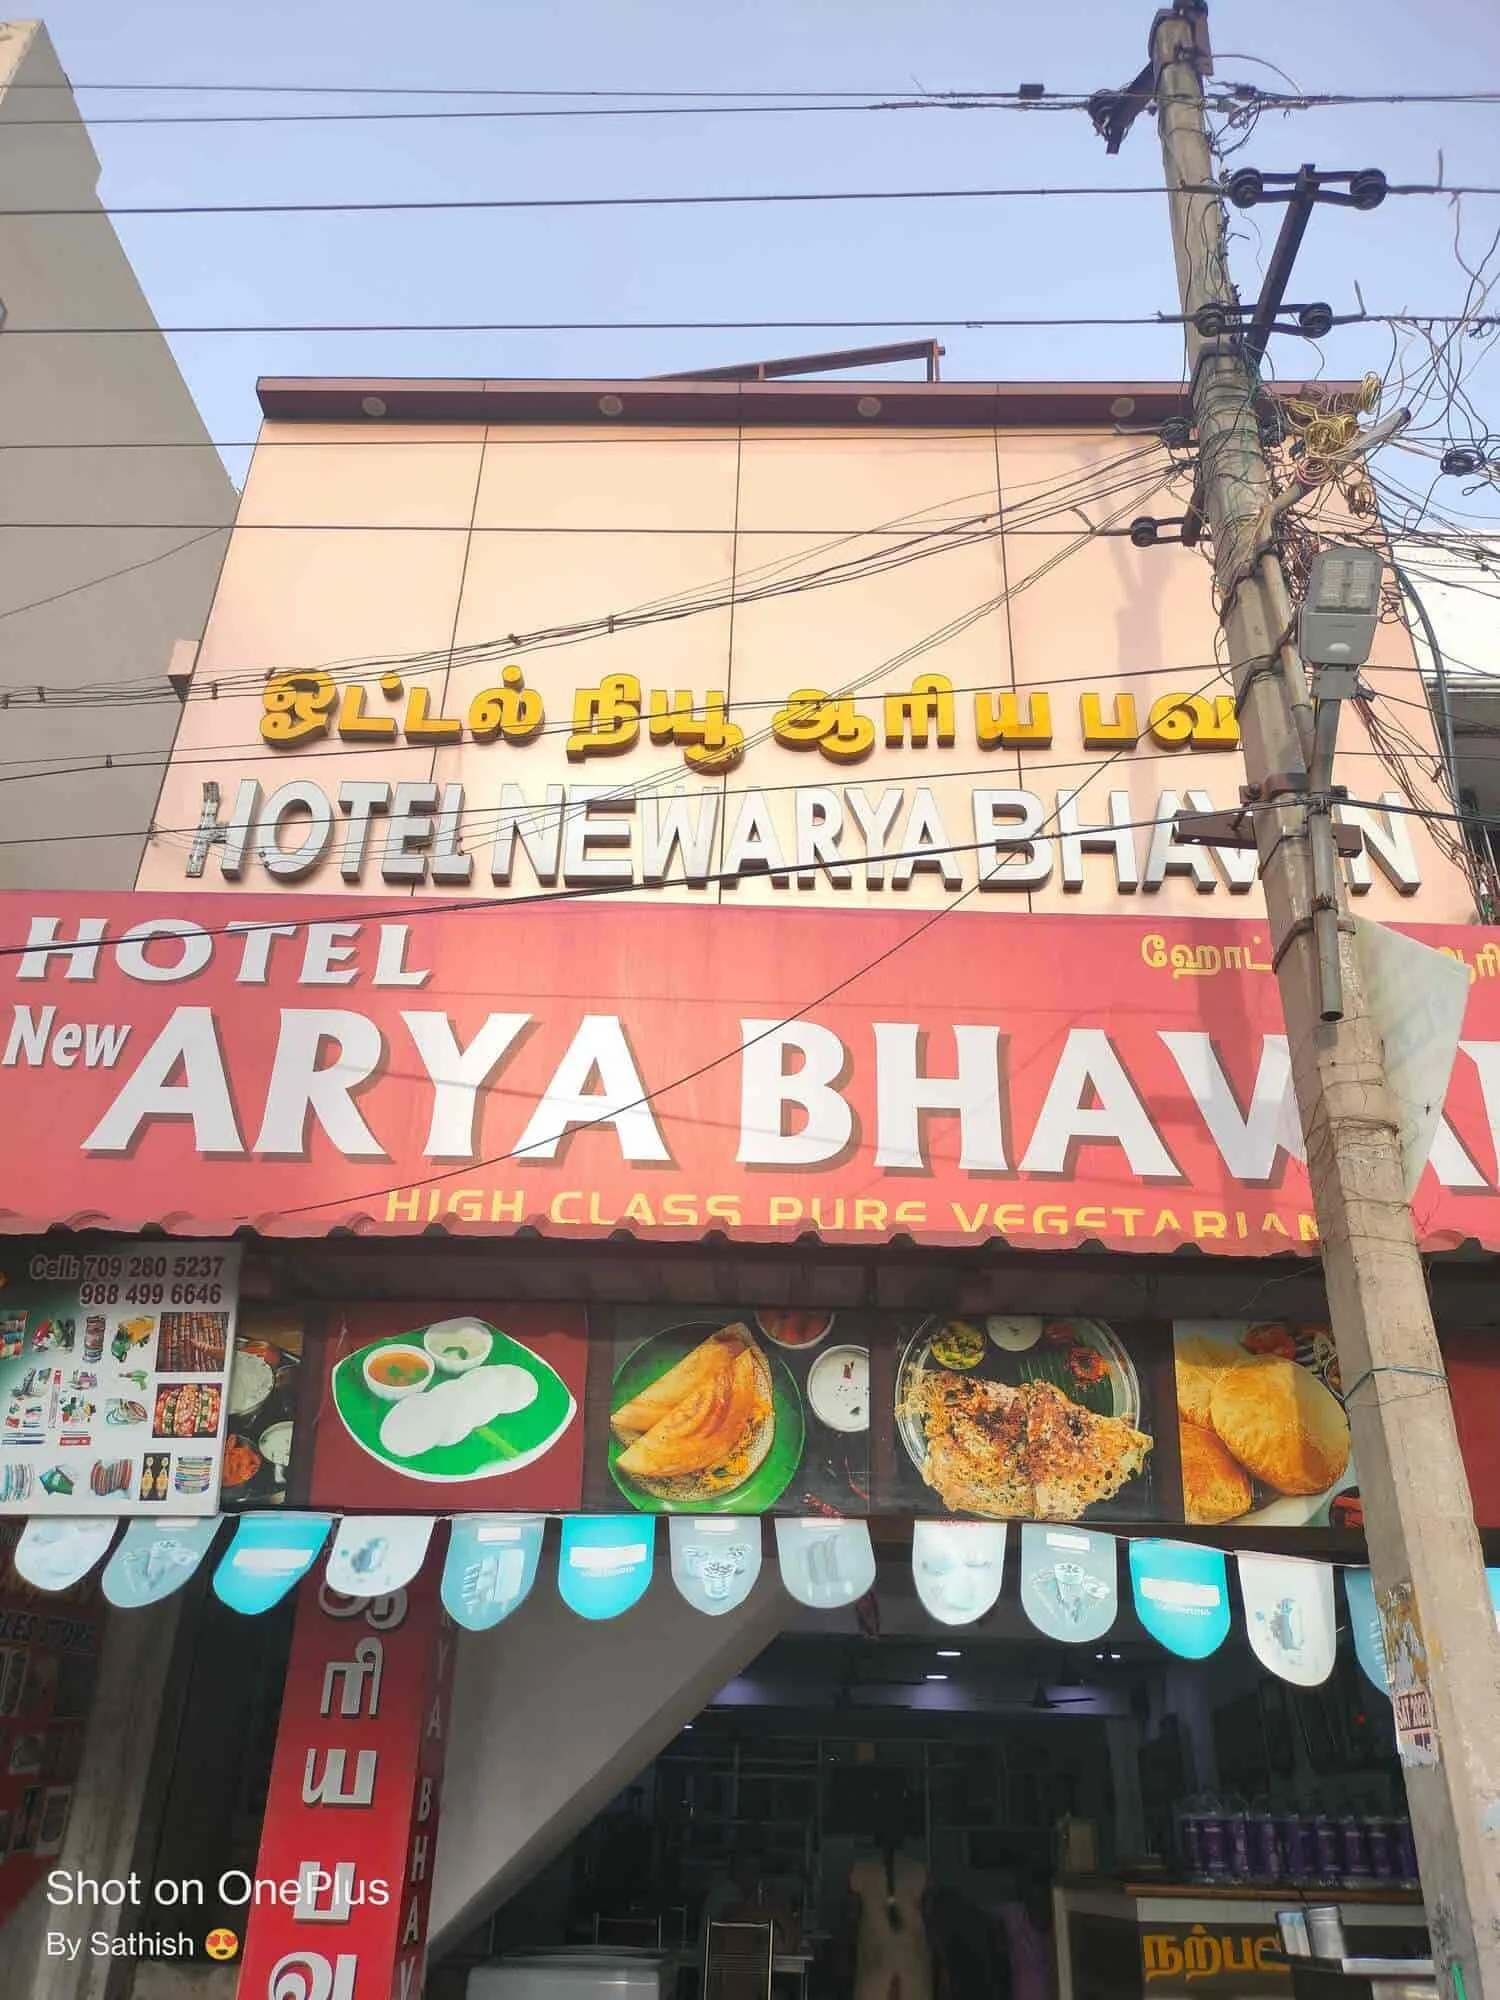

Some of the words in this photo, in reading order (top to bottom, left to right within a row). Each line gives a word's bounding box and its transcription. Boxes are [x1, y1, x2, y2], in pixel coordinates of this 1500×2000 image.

[260, 664, 545, 748] ஓட்டல்
[565, 672, 745, 775] நியூ
[772, 673, 1053, 764] ஆரிய
[186, 778, 474, 882] HOTEL
[972, 788, 1421, 897] BHAVN
[15, 916, 433, 988] HOTEL
[1, 1004, 132, 1068] New
[80, 1005, 672, 1163] ARYA
[384, 1187, 524, 1223] HIGH
[550, 1191, 743, 1227] CLASS
[769, 1195, 928, 1231] PURE
[30, 1253, 79, 1280] Cell:
[83, 1254, 124, 1279] 709
[171, 1254, 226, 1279] 5237
[125, 1282, 165, 1306] 499
[169, 1281, 223, 1306] 6646
